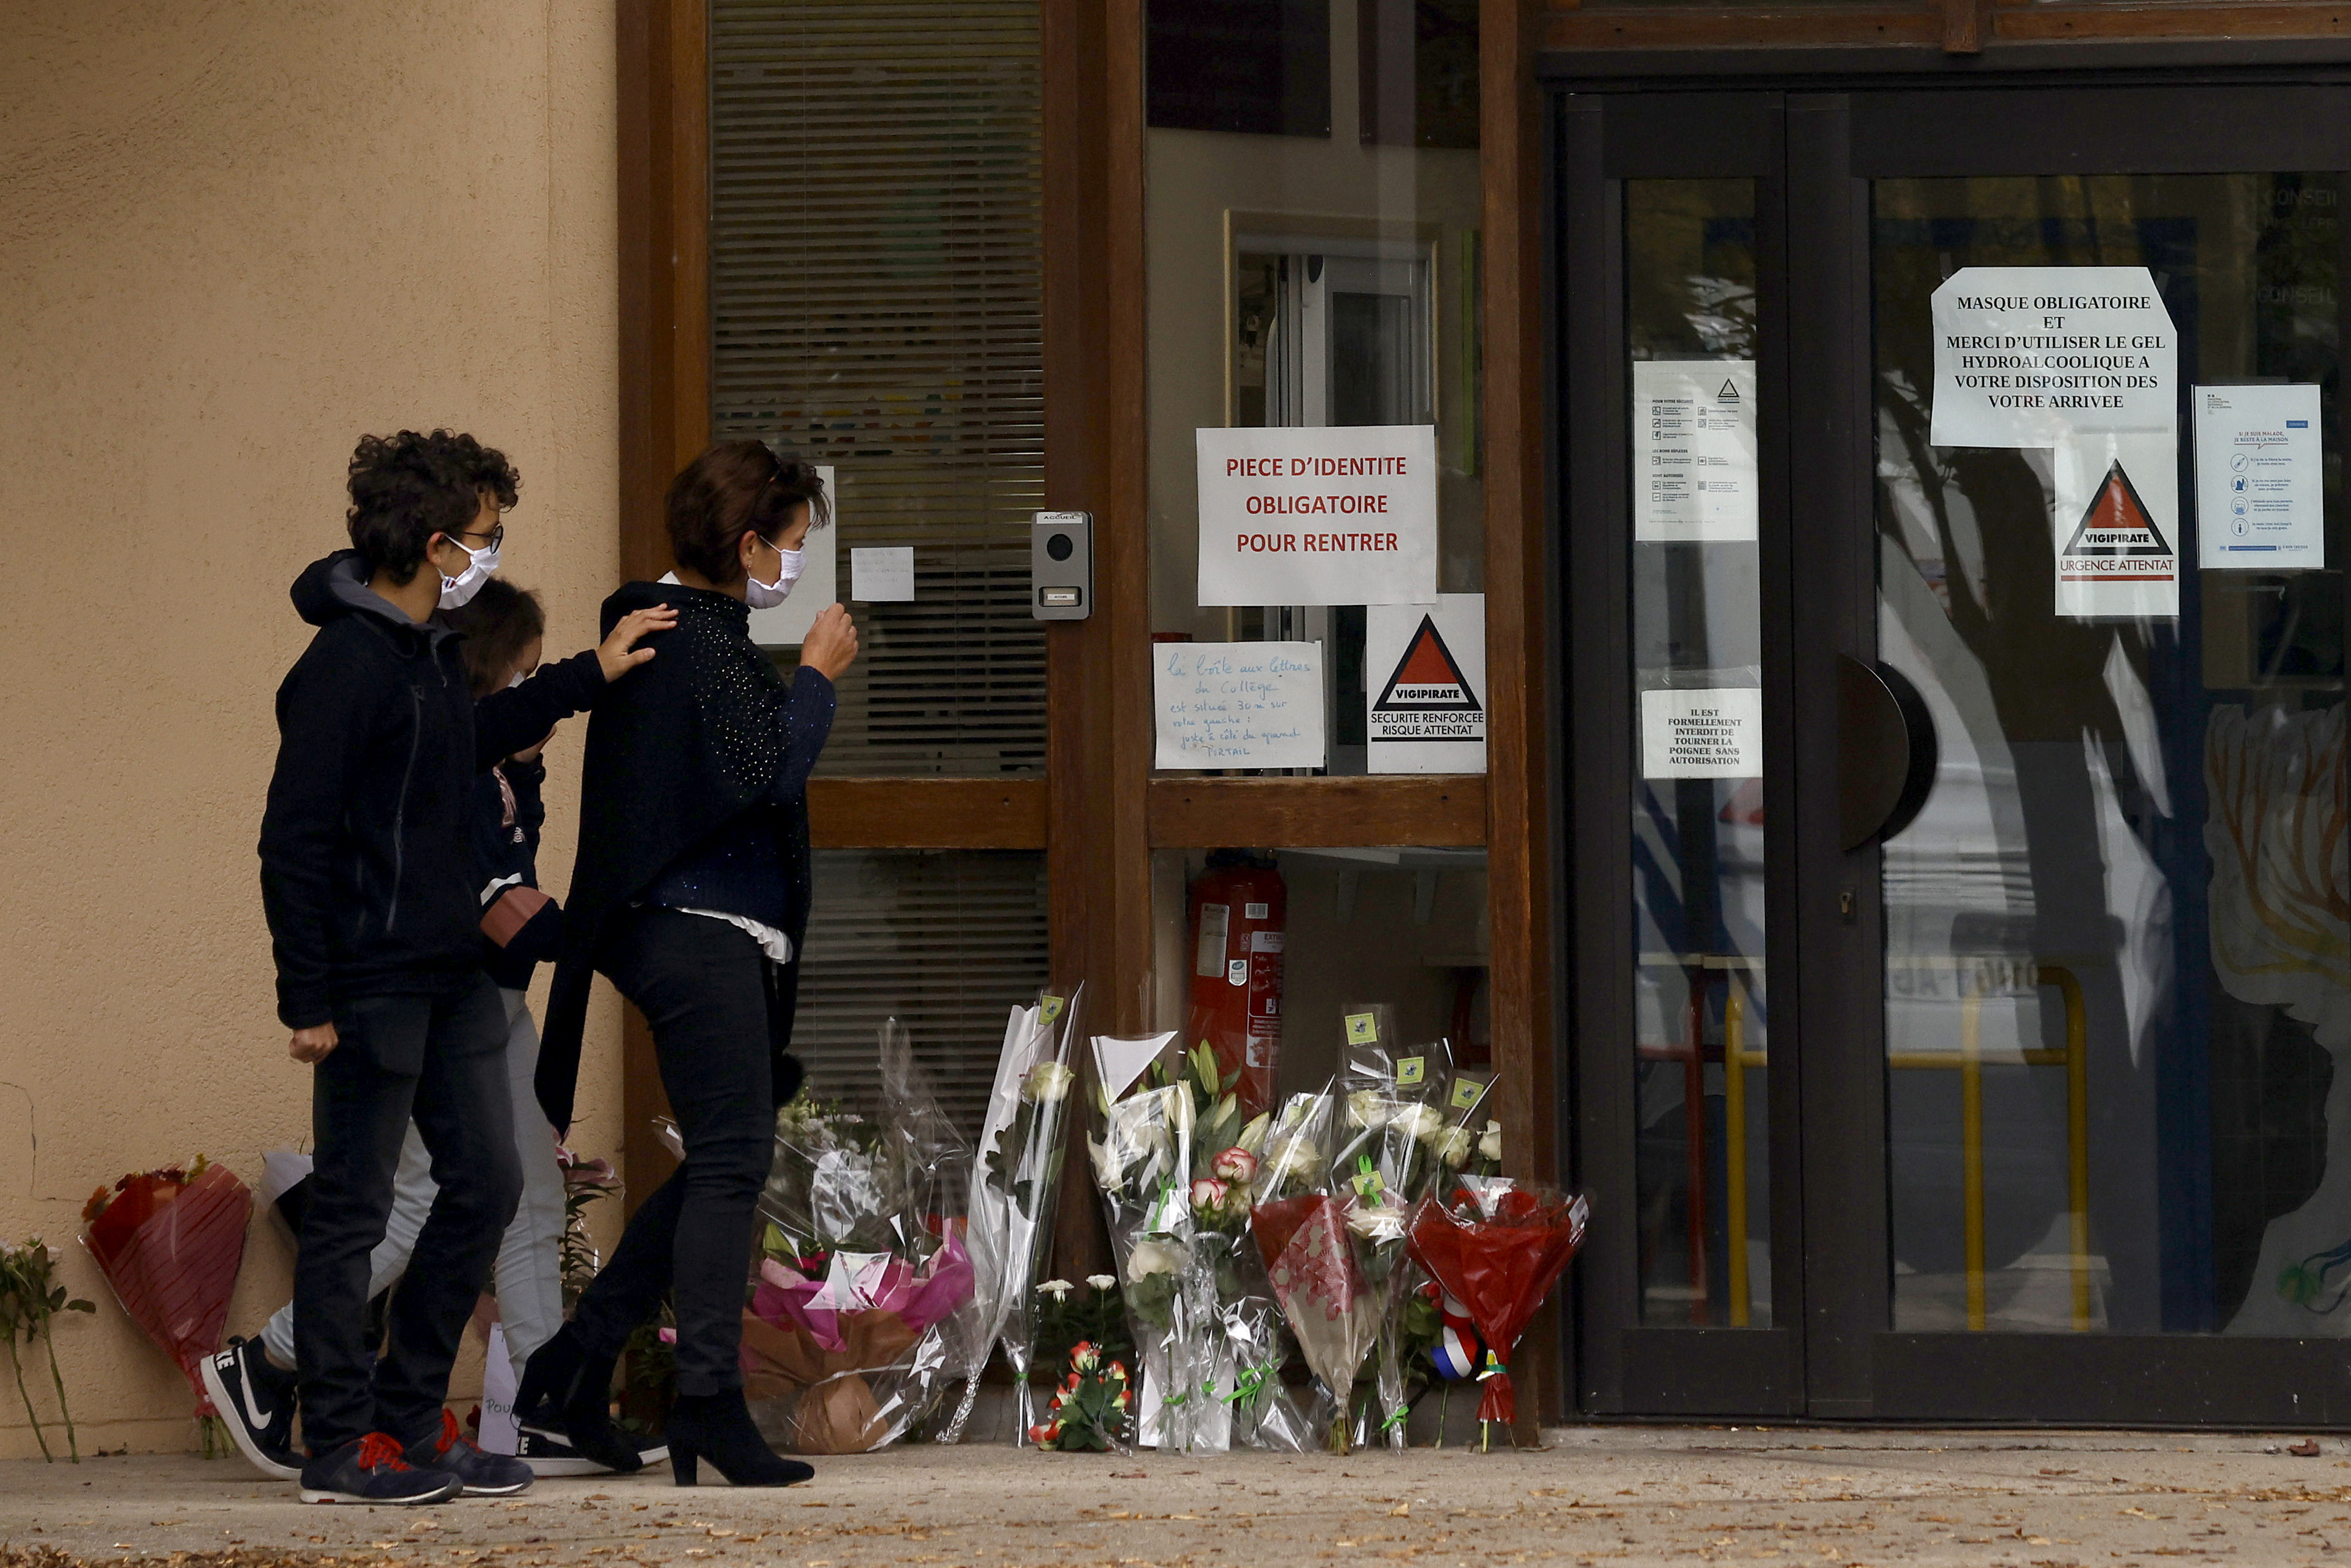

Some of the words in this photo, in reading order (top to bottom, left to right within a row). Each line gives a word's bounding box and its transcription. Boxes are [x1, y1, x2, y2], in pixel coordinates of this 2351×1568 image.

[1957, 296, 2029, 312] MASQUE
[2033, 296, 2151, 310] OBLIGATOIRE
[2043, 315, 2065, 329] ET
[1946, 336, 2001, 350] MERCI
[2004, 335, 2101, 349] D'UTILISER
[2105, 335, 2128, 349] LE
[2131, 335, 2166, 349] GEL
[1961, 355, 2134, 371] HYDROALCOOLIQUE
[2137, 355, 2150, 369] A
[1955, 375, 2011, 389] VOTRE
[2015, 375, 2122, 389] DISPOSITION
[2126, 374, 2158, 388] DES
[1988, 394, 2045, 408] VOTRE
[2048, 394, 2124, 408] ARRIVEE
[1226, 458, 1283, 477] PIECE
[1292, 457, 1406, 477] D'IDENTITE
[1245, 495, 1388, 515] OBLIGATOIRE
[1237, 533, 1297, 552] POUR
[1304, 532, 1398, 552] RENTRER
[2085, 533, 2150, 544] VIGIPIRATE
[2060, 559, 2116, 571] URGENCE
[2118, 558, 2174, 570] ATTENTAT
[1197, 654, 1232, 676] boîte
[1269, 656, 1311, 673] lettres
[1195, 681, 1210, 694] du
[1396, 689, 1460, 700] VIGIPIRATE
[1170, 704, 1186, 713] est
[1173, 717, 1195, 727] votre
[1203, 715, 1241, 733] gauche
[1371, 713, 1420, 723] SECURITE
[1422, 712, 1484, 723] RENFORCEE
[1181, 733, 1205, 749] juste
[1220, 730, 1240, 740] côté
[1243, 729, 1256, 740] du
[1261, 727, 1301, 744] grand
[1382, 725, 1421, 737] RISQUE
[1423, 725, 1473, 735] ATTENTAT
[1205, 747, 1251, 757] PORTAIL
